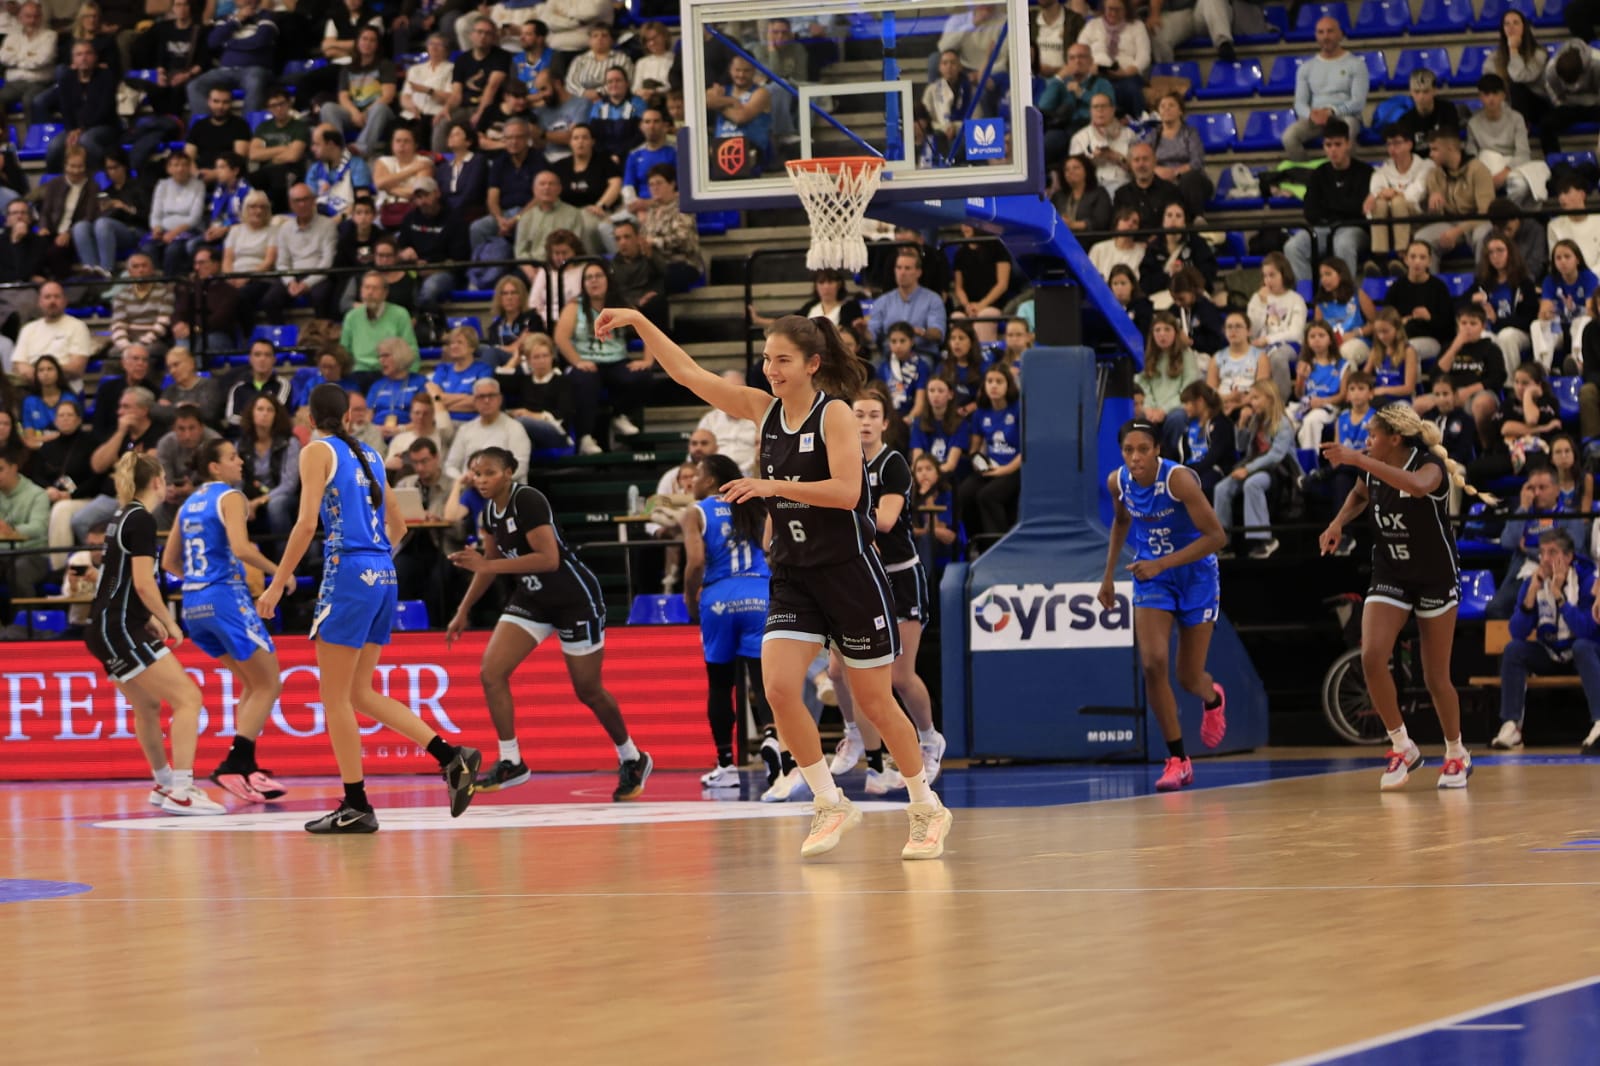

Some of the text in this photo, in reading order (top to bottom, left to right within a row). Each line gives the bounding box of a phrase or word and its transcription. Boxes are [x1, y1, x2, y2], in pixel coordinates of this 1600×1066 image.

[788, 520, 807, 543] 6
[1148, 536, 1175, 555] 55
[1388, 543, 1410, 560] 15
[185, 537, 209, 578] 13
[727, 540, 753, 572] 11
[522, 575, 542, 591] 23
[1087, 730, 1133, 742] MONDO
